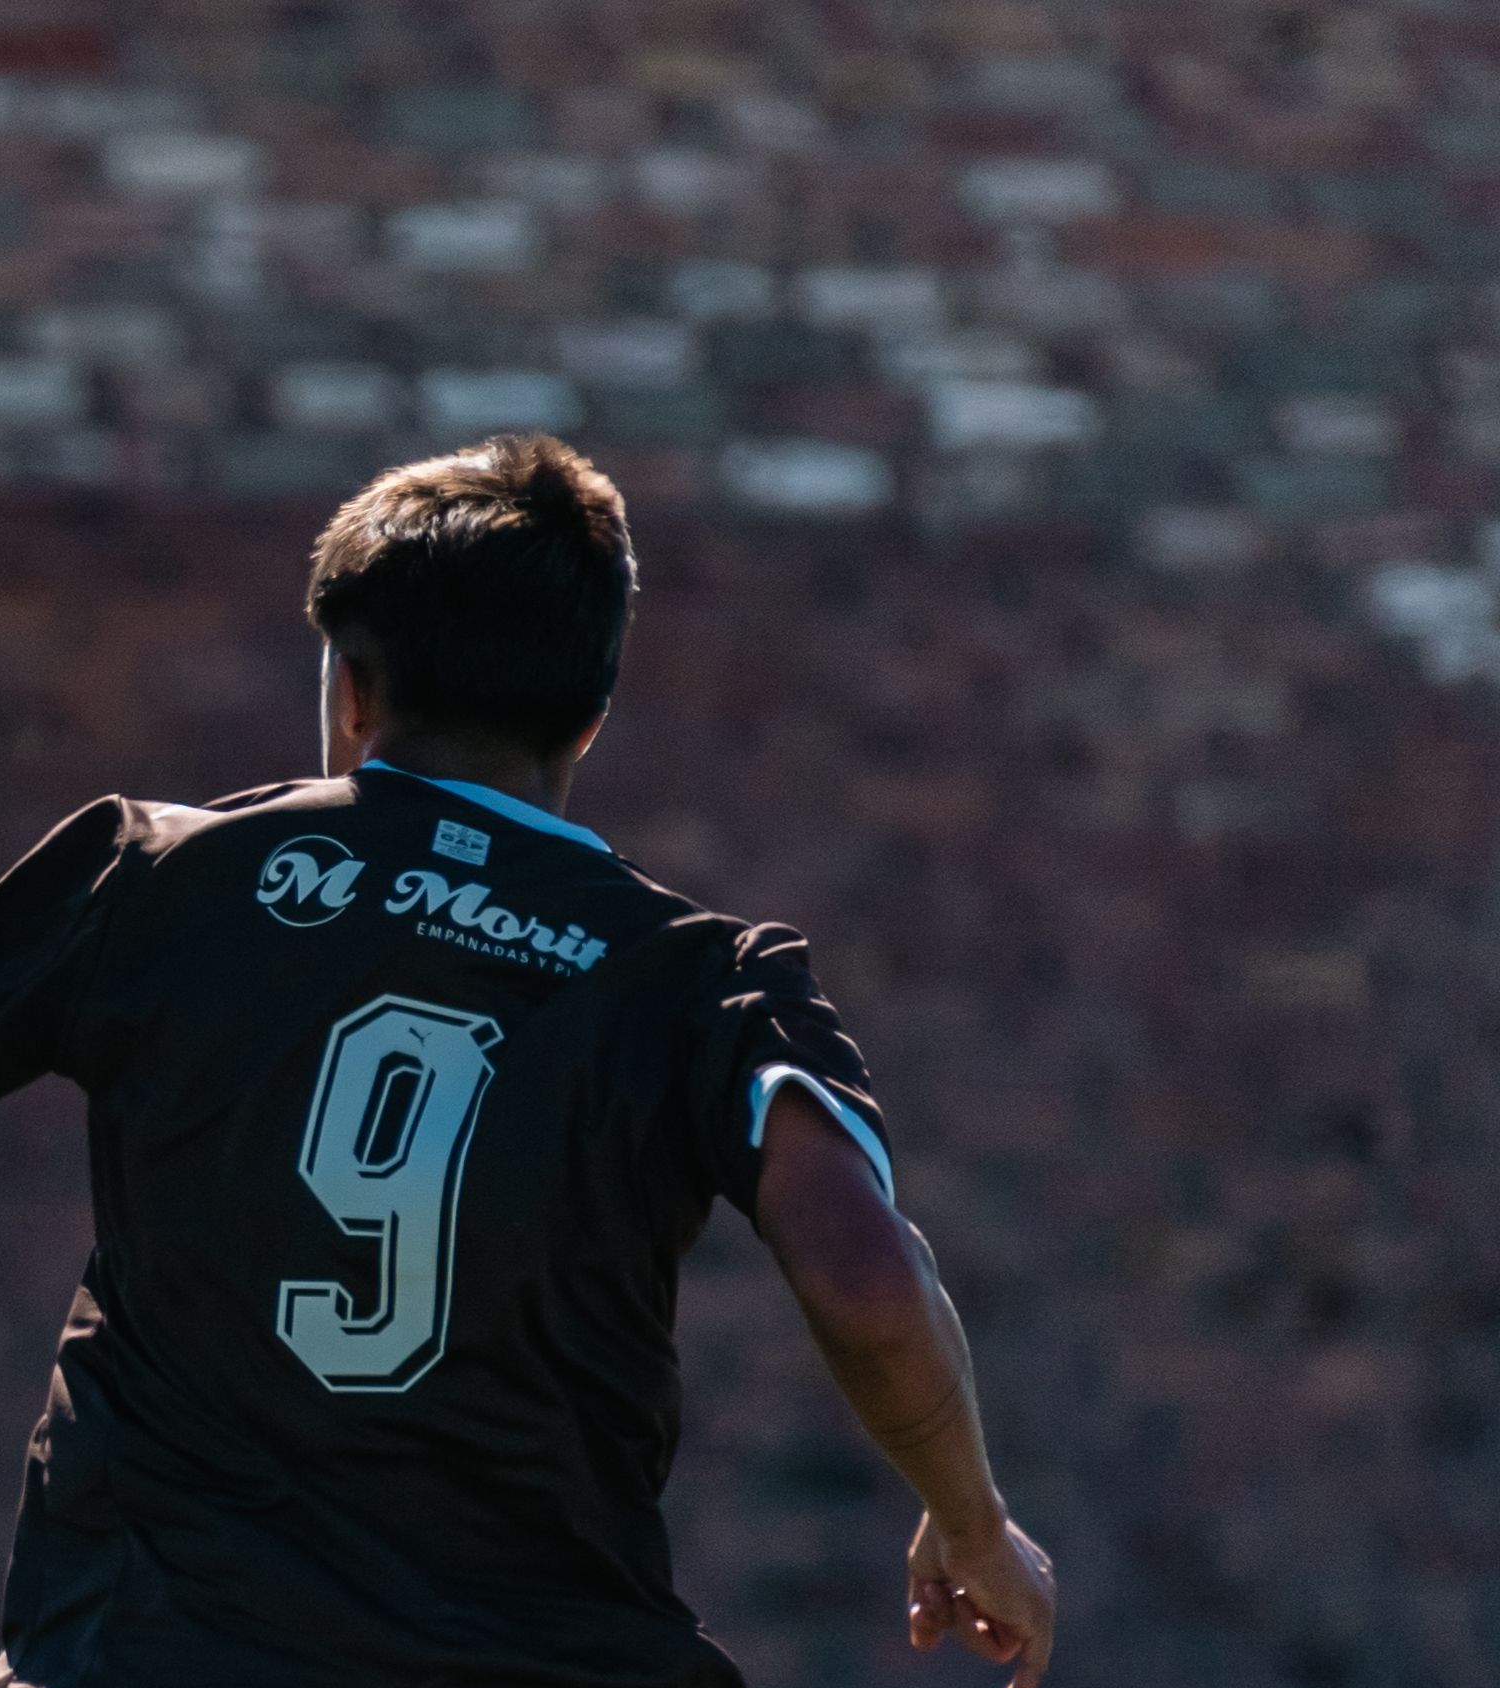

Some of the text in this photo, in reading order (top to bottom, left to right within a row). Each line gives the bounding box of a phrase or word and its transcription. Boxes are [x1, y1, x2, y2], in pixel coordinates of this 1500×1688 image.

[256, 852, 366, 908] M
[416, 922, 529, 963] EMPANADAS
[539, 957, 549, 969] Y
[276, 993, 504, 1393] 9
